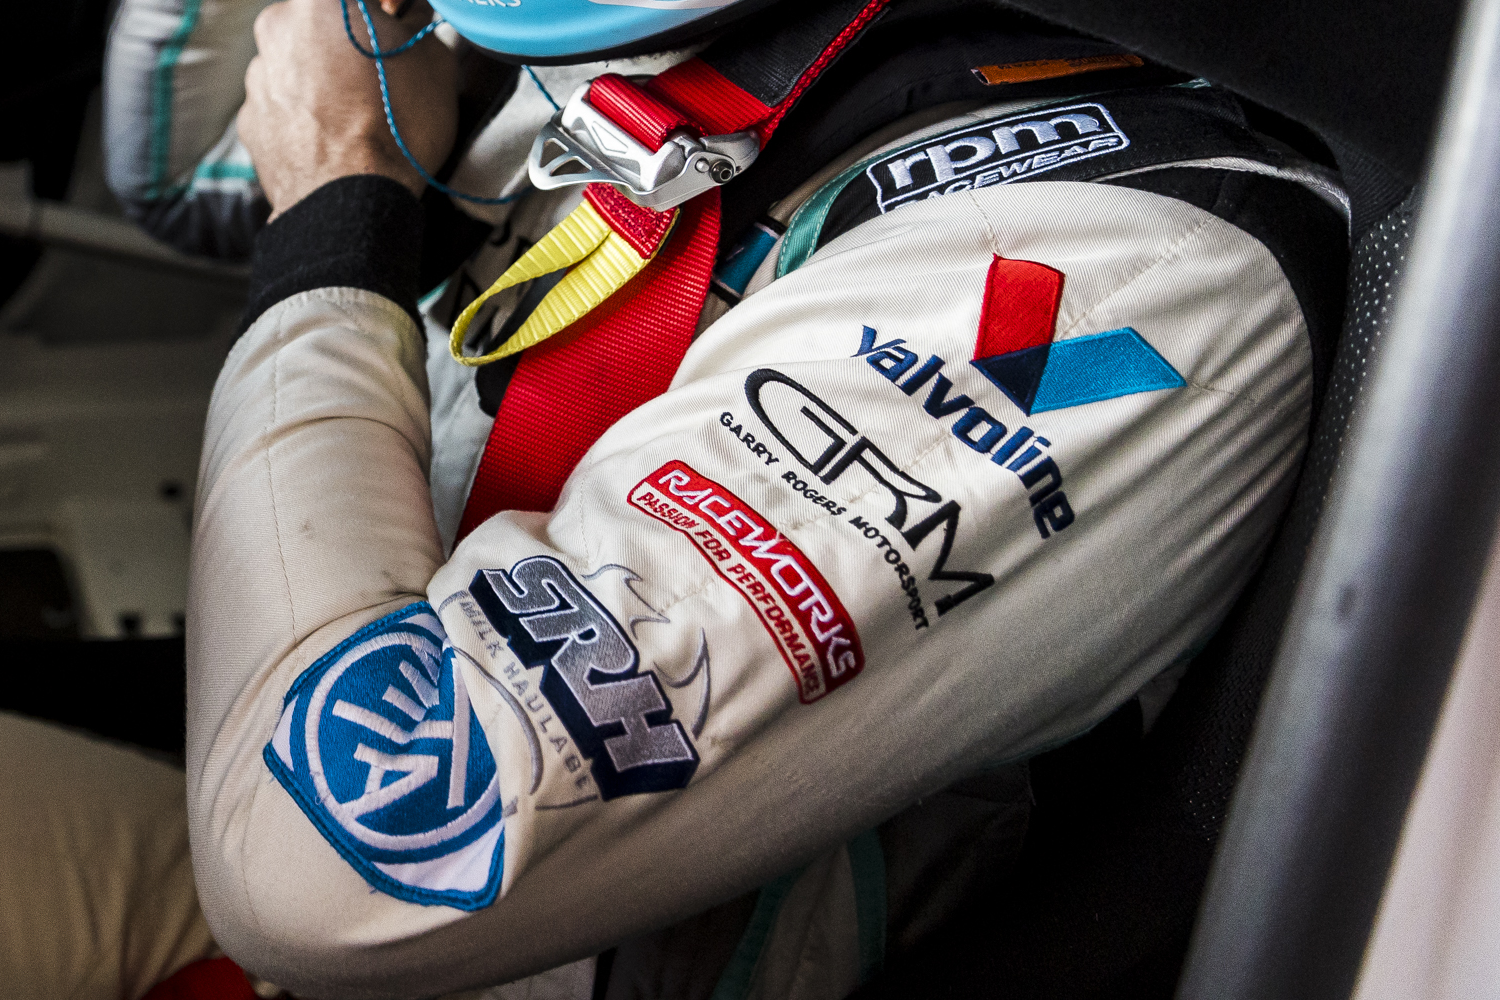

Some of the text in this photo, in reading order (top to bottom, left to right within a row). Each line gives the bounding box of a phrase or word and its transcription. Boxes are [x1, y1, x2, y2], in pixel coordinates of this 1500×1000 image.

[887, 113, 1102, 190] rpm
[894, 137, 1120, 209] ACEWEAR
[636, 491, 822, 696] PASSION FOR PERFORMANCE
[658, 468, 856, 680] RACEWORKS
[719, 411, 930, 631] GARRY ROGERS MOTORSPORT
[744, 368, 995, 617] GRM
[459, 596, 593, 790] MILK HAULAGE
[474, 556, 699, 790] SRH
